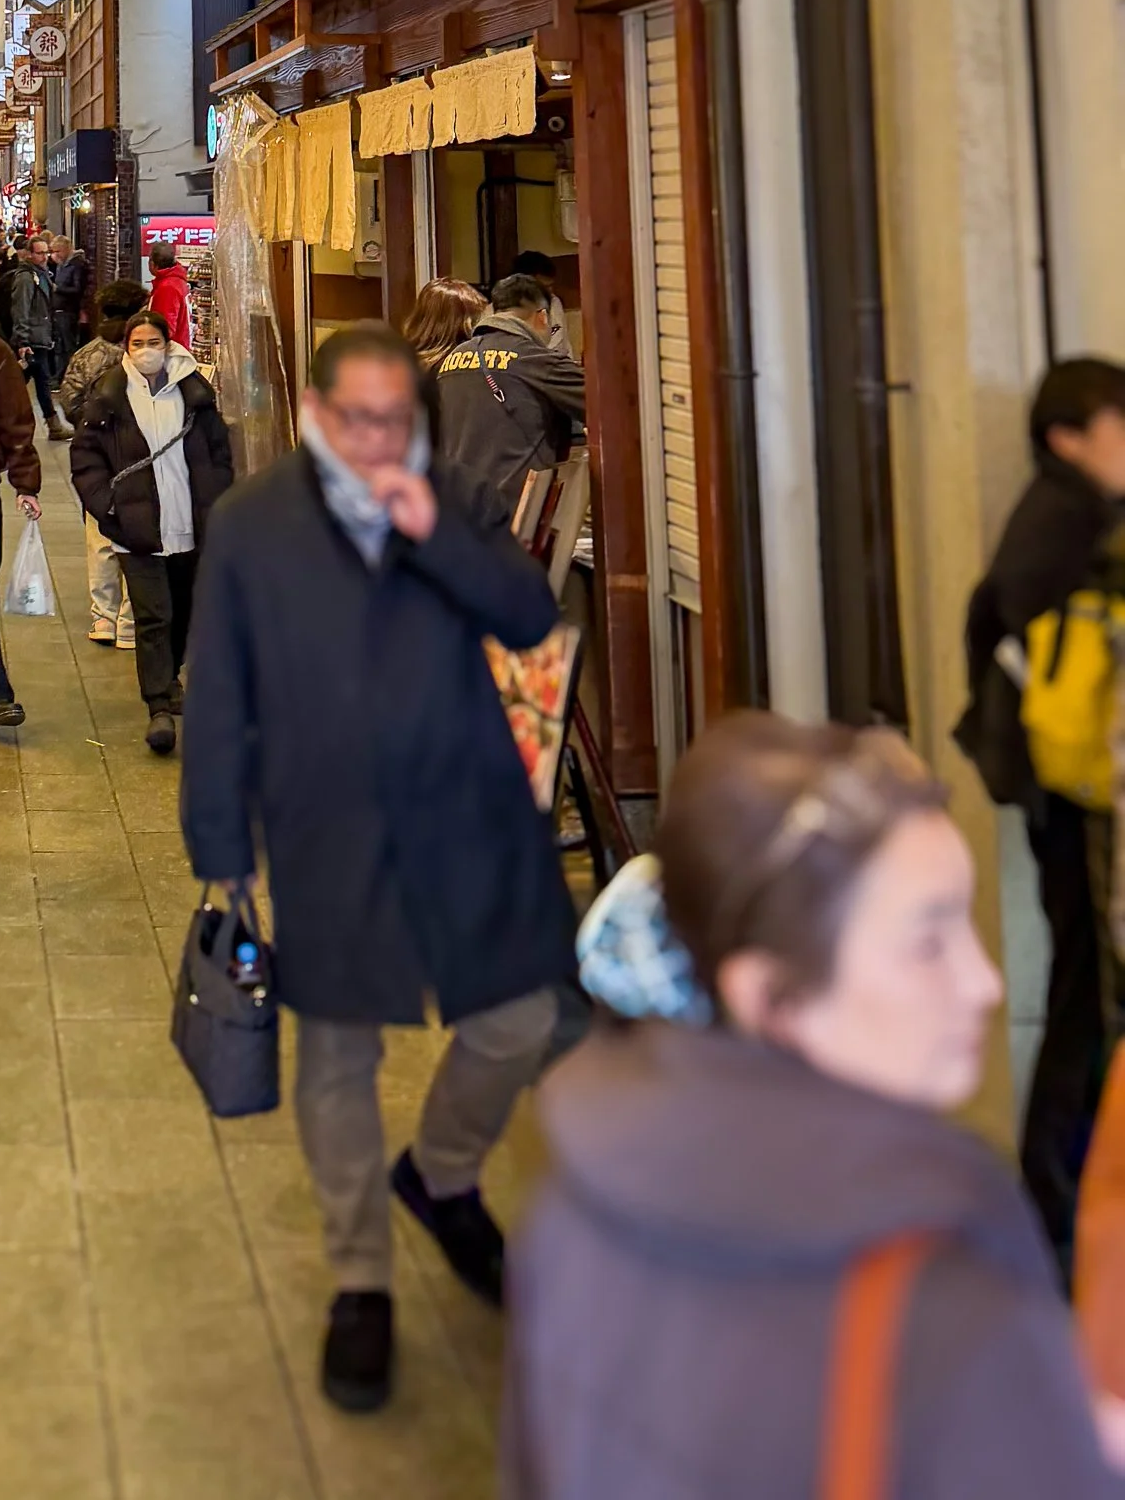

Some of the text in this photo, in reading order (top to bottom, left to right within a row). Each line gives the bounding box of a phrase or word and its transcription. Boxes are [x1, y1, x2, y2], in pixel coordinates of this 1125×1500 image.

[36, 30, 58, 57] 錦
[146, 227, 216, 243] スギドラ
